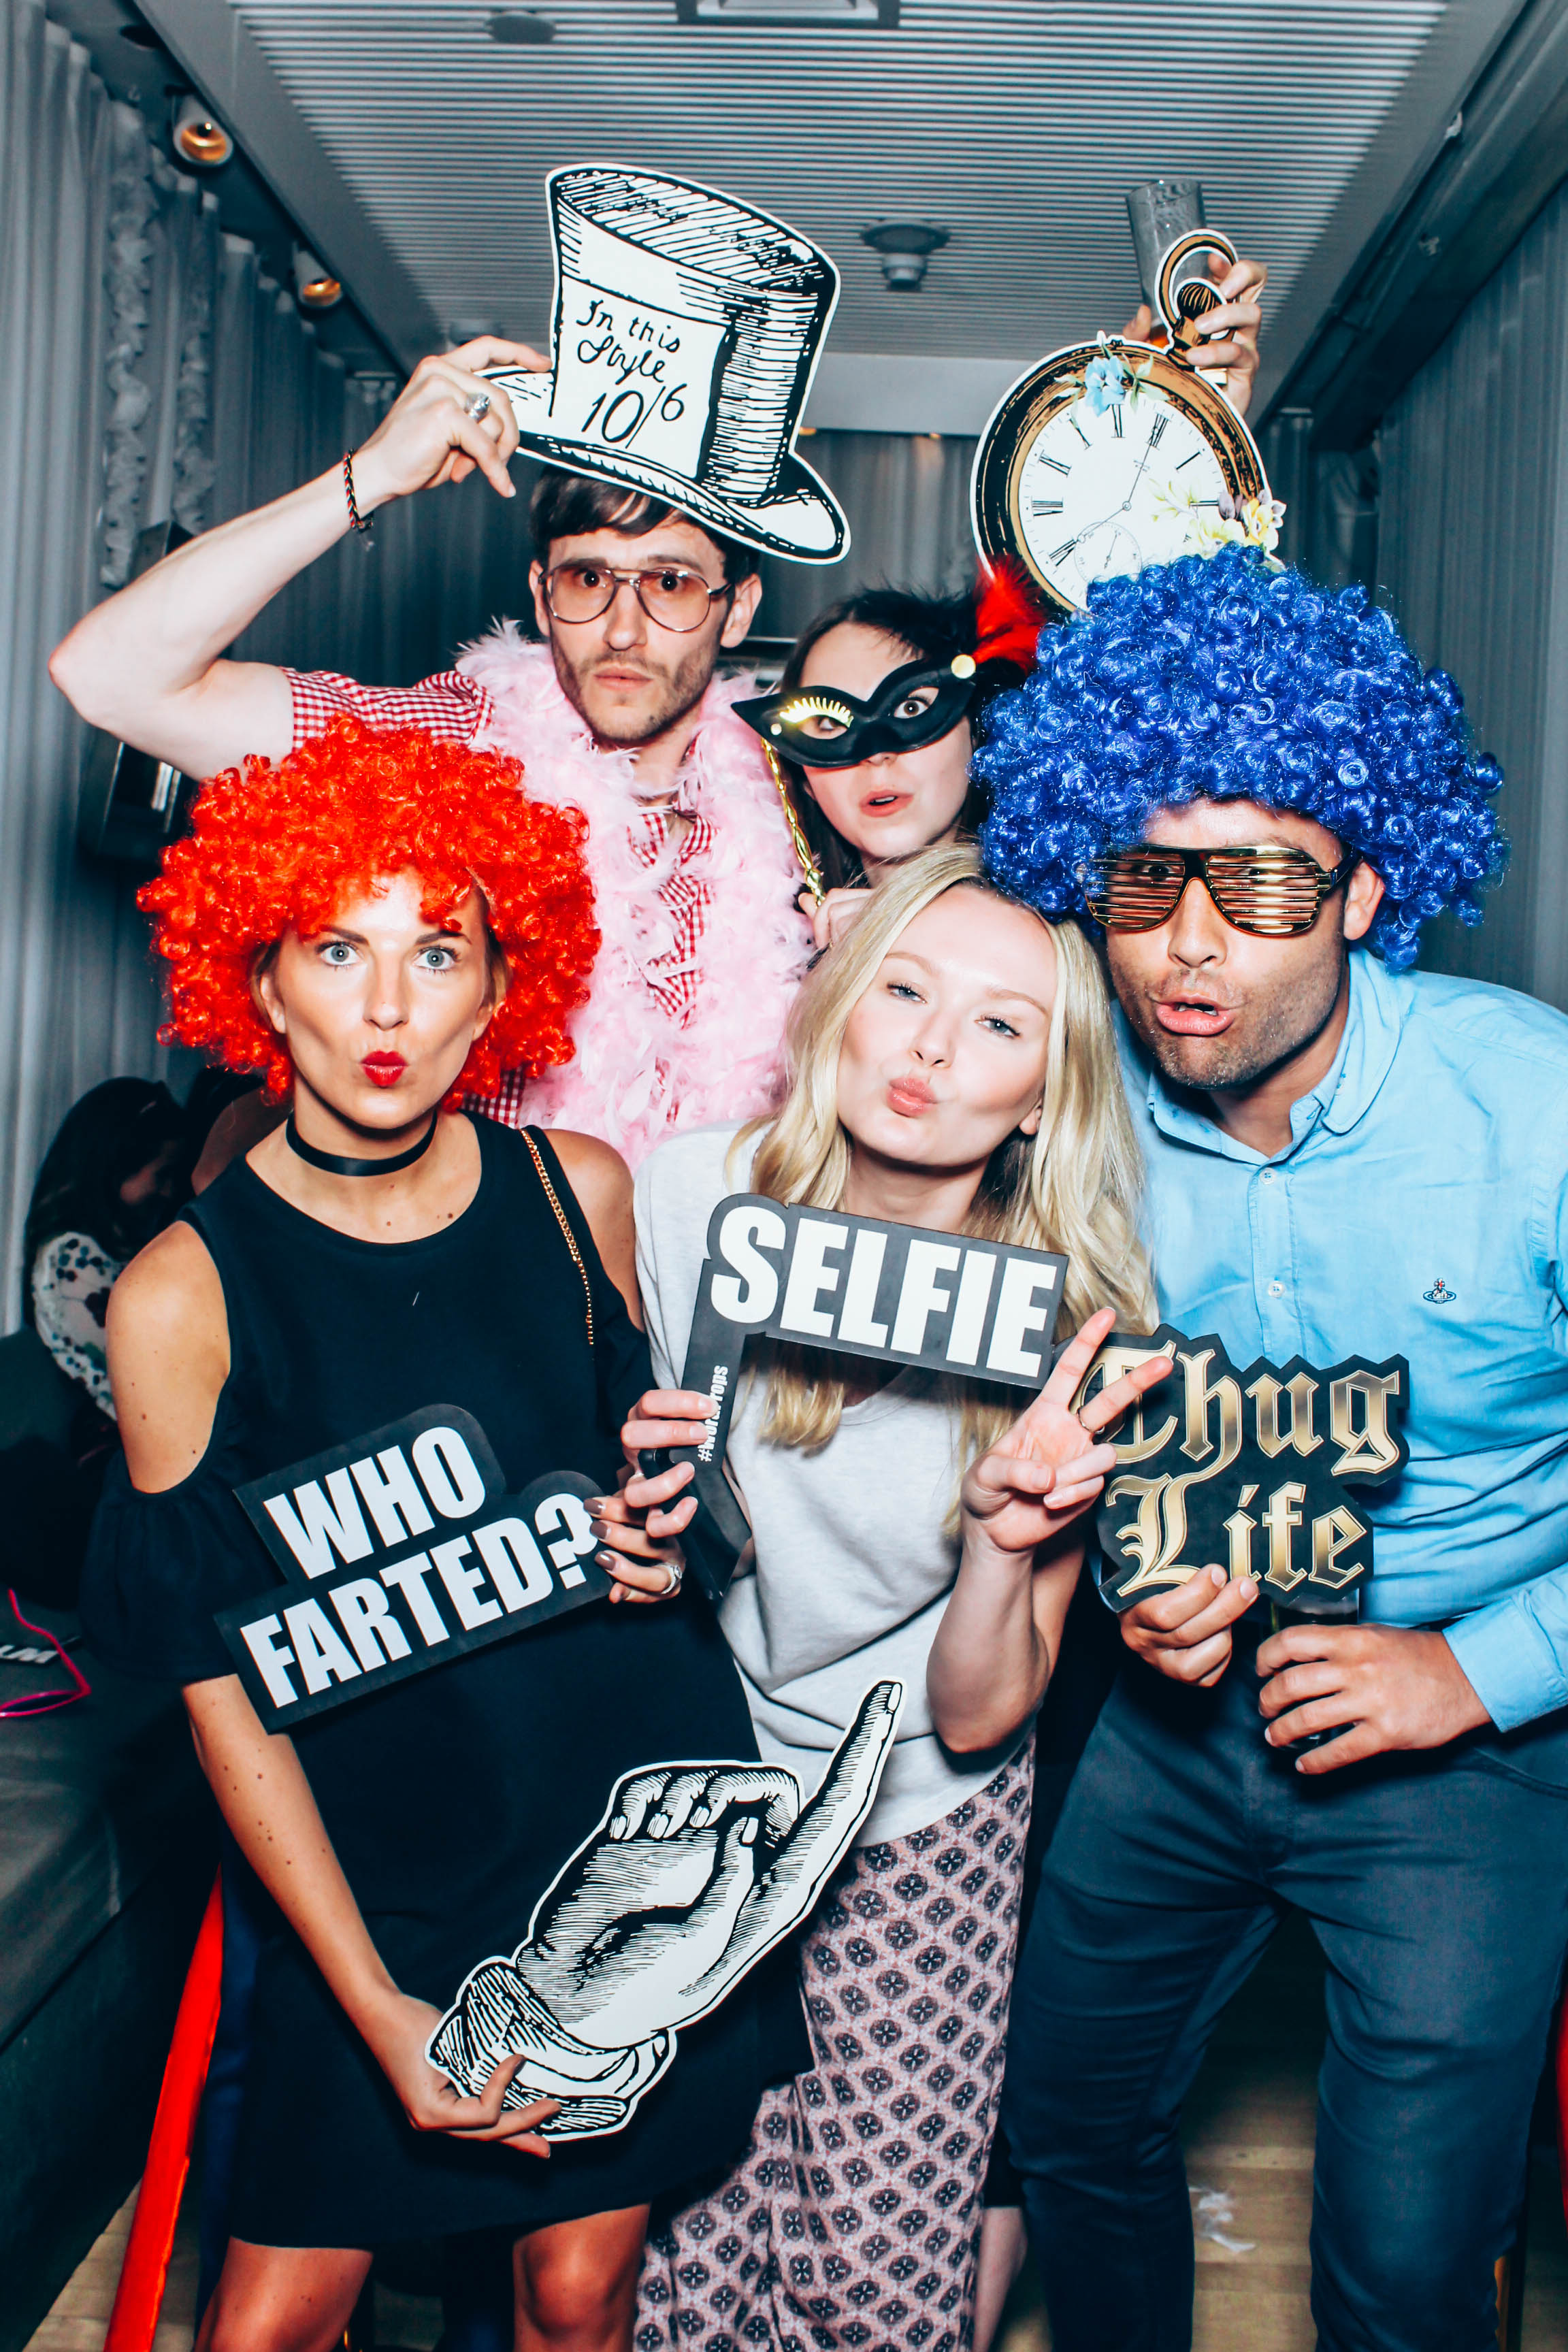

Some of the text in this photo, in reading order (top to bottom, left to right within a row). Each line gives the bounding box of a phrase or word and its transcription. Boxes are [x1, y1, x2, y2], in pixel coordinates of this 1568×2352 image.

[629, 316, 681, 353] this
[581, 383, 687, 449] 10/6
[711, 1206, 1058, 1378] SELFIE
[1068, 1339, 1400, 1478] Thug
[264, 1426, 485, 1580] WHO
[1105, 1472, 1367, 1597] Life
[240, 1493, 598, 1708] FARTED?
